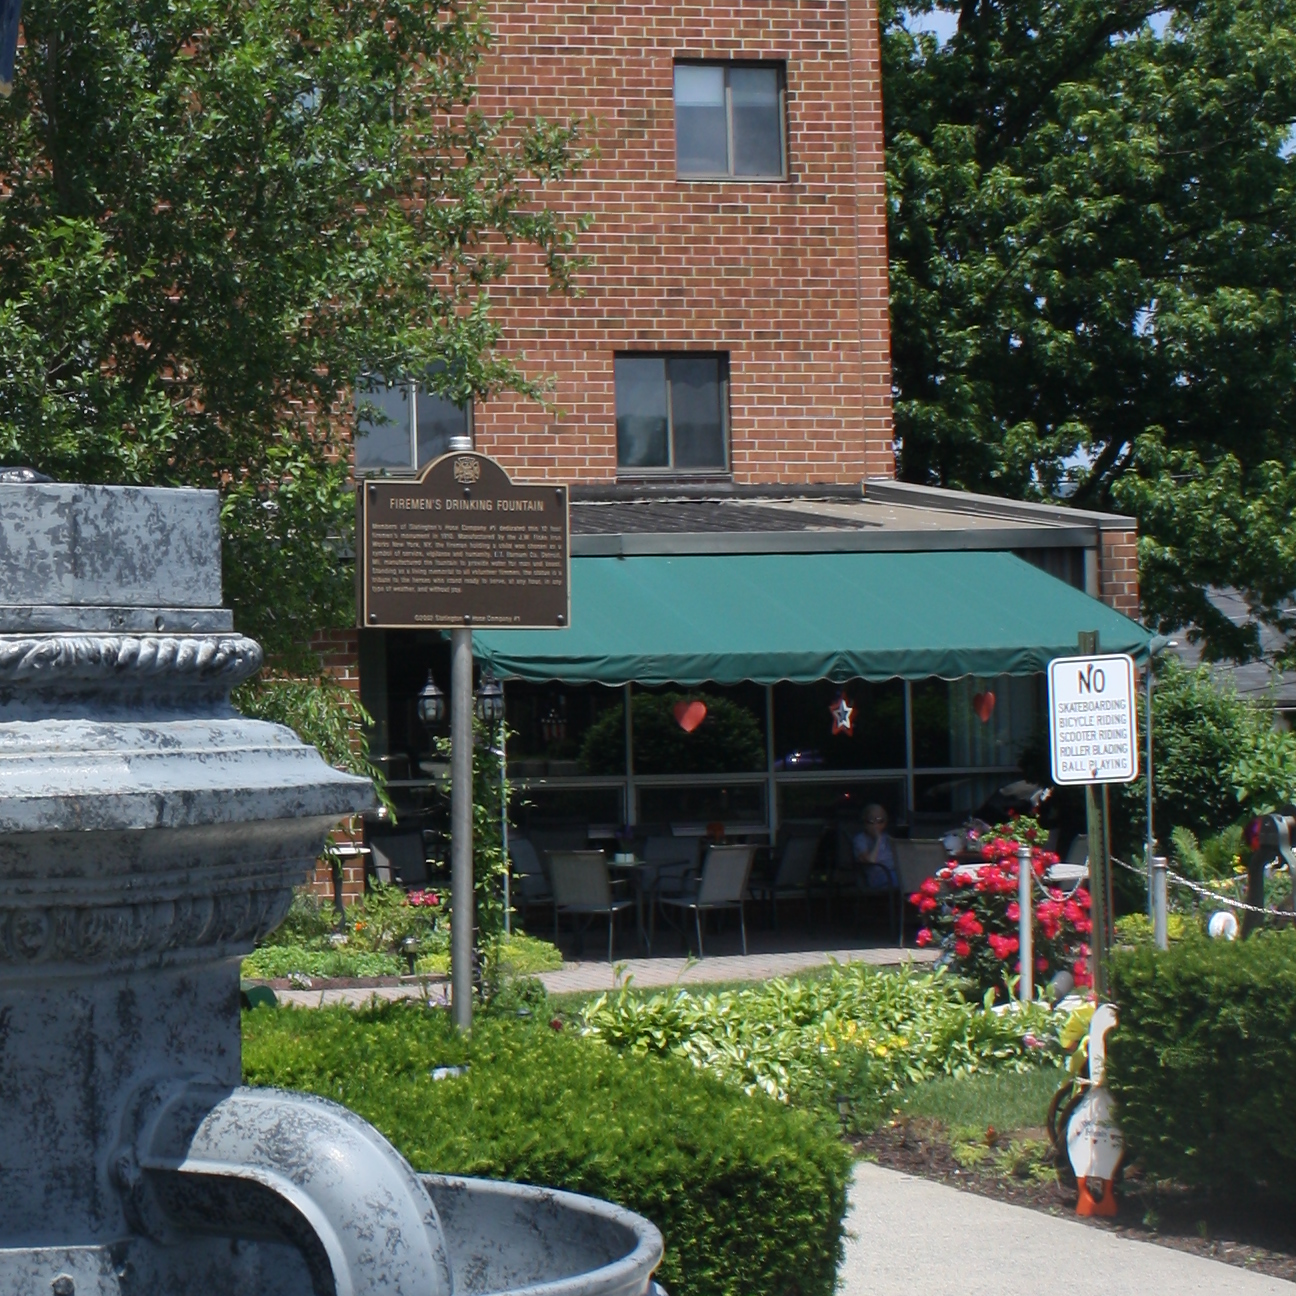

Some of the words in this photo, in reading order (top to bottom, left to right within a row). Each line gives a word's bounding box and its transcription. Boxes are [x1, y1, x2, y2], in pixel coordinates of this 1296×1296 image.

[389, 498, 442, 510] FIREMEN'S
[445, 499, 493, 511] DRINKING
[496, 500, 544, 512] FOUNTAIN
[1078, 669, 1105, 694] NO
[1058, 699, 1126, 713] SKATEBOARDING
[1059, 715, 1094, 728] BICYCLE
[1096, 714, 1127, 726] RIDING
[1059, 730, 1096, 743] SCOOTER
[1098, 728, 1128, 740] RIDING
[1060, 745, 1090, 757] ROLLER
[1092, 743, 1128, 756] BLADING
[1062, 761, 1086, 772] BALL
[1088, 758, 1128, 771] PLAYING
